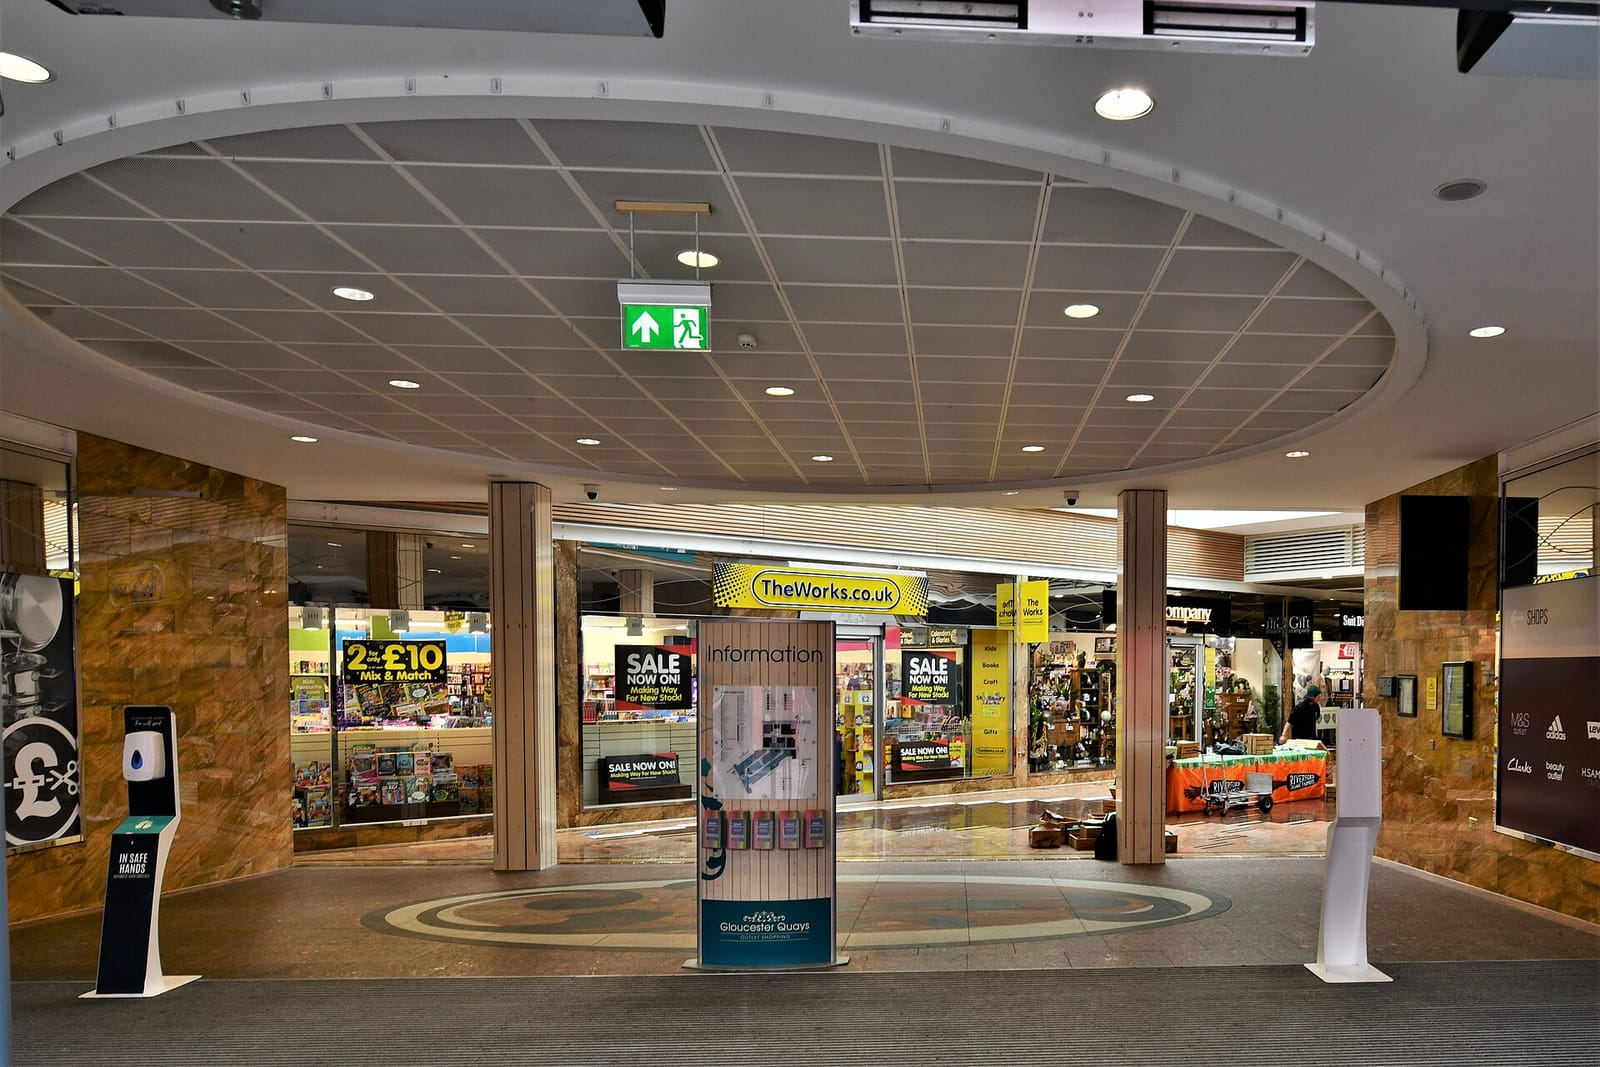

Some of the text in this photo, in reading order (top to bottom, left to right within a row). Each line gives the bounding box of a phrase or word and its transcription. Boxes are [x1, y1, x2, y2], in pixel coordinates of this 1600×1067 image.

[761, 579, 893, 602] TheWorks.co.uk
[1027, 598, 1039, 606] The
[1023, 608, 1044, 616] Works
[1527, 608, 1548, 625] SHOPS
[1289, 615, 1311, 629] Gift
[1343, 615, 1356, 626] Suit
[347, 643, 368, 670] 2
[367, 656, 381, 664] only
[381, 644, 443, 670] £10
[707, 645, 823, 663] Information
[627, 653, 680, 674] SALE
[909, 657, 948, 675] SALE
[360, 671, 432, 680] Mix & Match
[627, 674, 681, 685] NOW ON!
[909, 675, 948, 684] NOW ON!
[630, 686, 678, 695] Making Way
[911, 685, 933, 693] Making
[626, 694, 638, 702] For
[659, 693, 682, 701] Stock!
[1511, 712, 1530, 728] M&S
[1546, 731, 1566, 740] adidas
[900, 748, 916, 756] SALE
[917, 747, 934, 755] NOW
[935, 746, 948, 754] ON!
[608, 760, 676, 773] SALE NOW ON!
[1507, 757, 1532, 774] Clarks
[1545, 761, 1565, 772] beauty
[1547, 772, 1563, 780] outlet
[119, 853, 148, 863] IN SAFE
[119, 863, 146, 874] HANDS
[720, 922, 810, 932] Gloucester Quays
